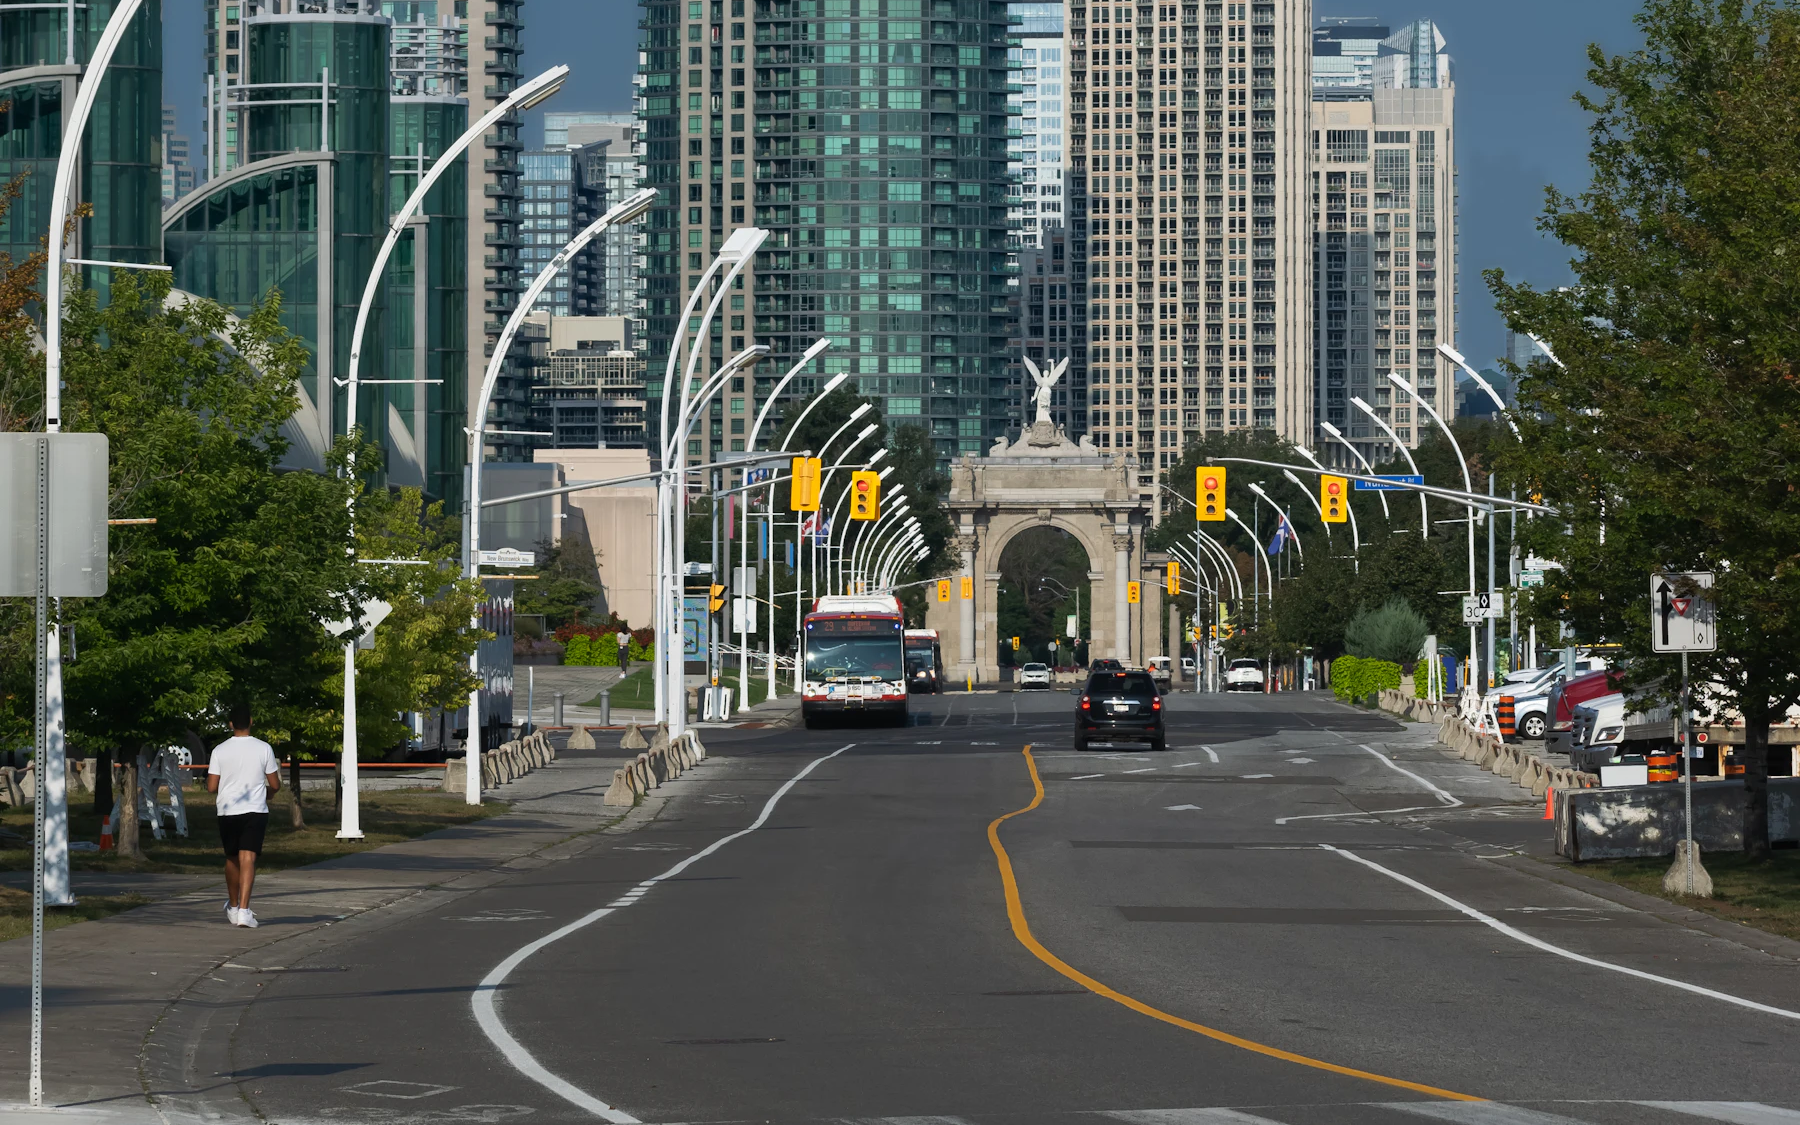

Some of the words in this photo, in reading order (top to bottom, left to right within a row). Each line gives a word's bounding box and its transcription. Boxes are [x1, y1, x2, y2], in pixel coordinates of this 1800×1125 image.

[1365, 477, 1406, 487] Nunat
[1466, 606, 1480, 617] 30
[824, 621, 834, 631] 29
